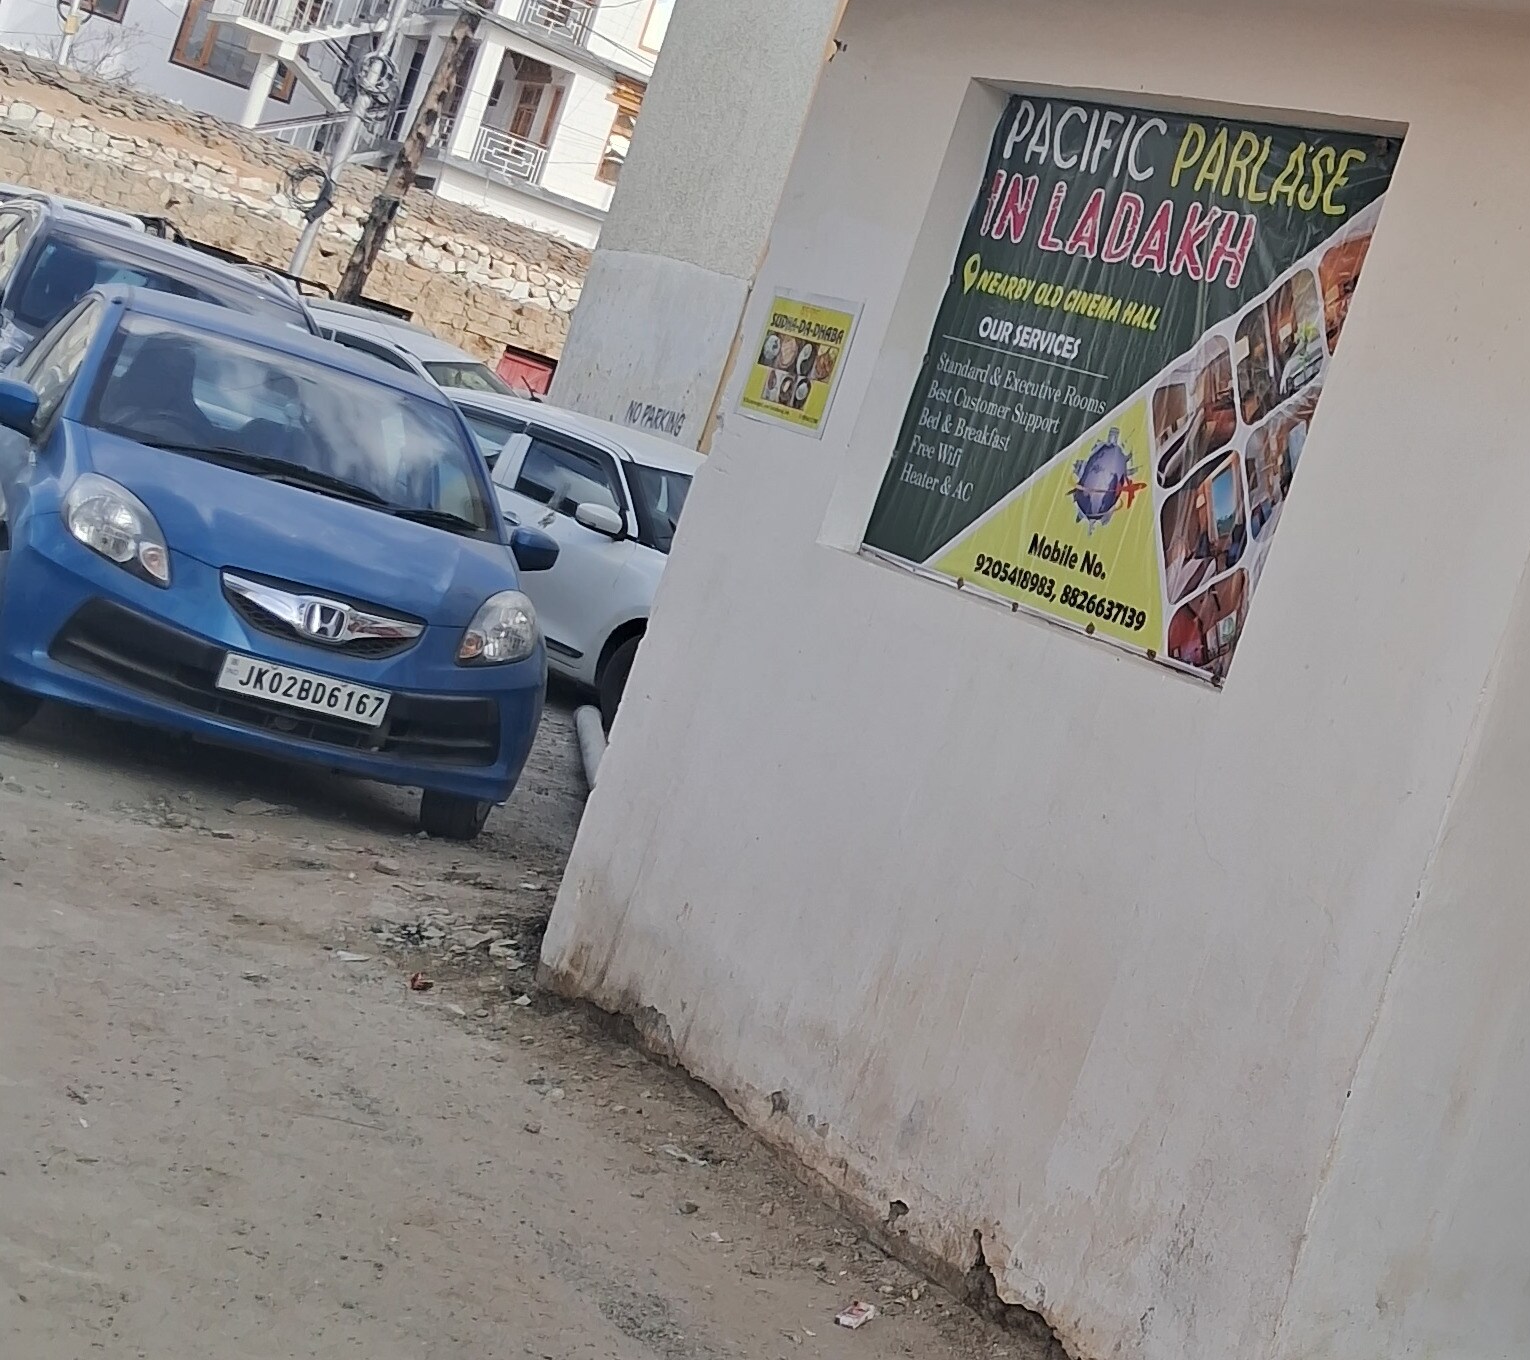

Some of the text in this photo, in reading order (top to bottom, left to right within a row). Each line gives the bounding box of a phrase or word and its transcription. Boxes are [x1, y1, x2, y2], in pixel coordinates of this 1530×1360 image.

[1002, 99, 1367, 215] PACIFIC PARLASE
[978, 169, 1258, 289] IN LADAKH
[976, 269, 1162, 332] NEARBY OLD CINEMA HALL
[978, 316, 1082, 360] OUR SERVICES
[936, 351, 1107, 415] Standard & Executive Rooms
[625, 400, 687, 437] NO PARKING
[917, 407, 1012, 452] Bed & Breakfast
[927, 381, 1060, 434] Best Customer Support
[908, 433, 963, 468] Free Wifi
[900, 462, 974, 503] Heater & AC
[1028, 533, 1107, 581] Mobile No.
[1059, 585, 1147, 632] 8826637139
[238, 665, 385, 719] JK02BD6167
